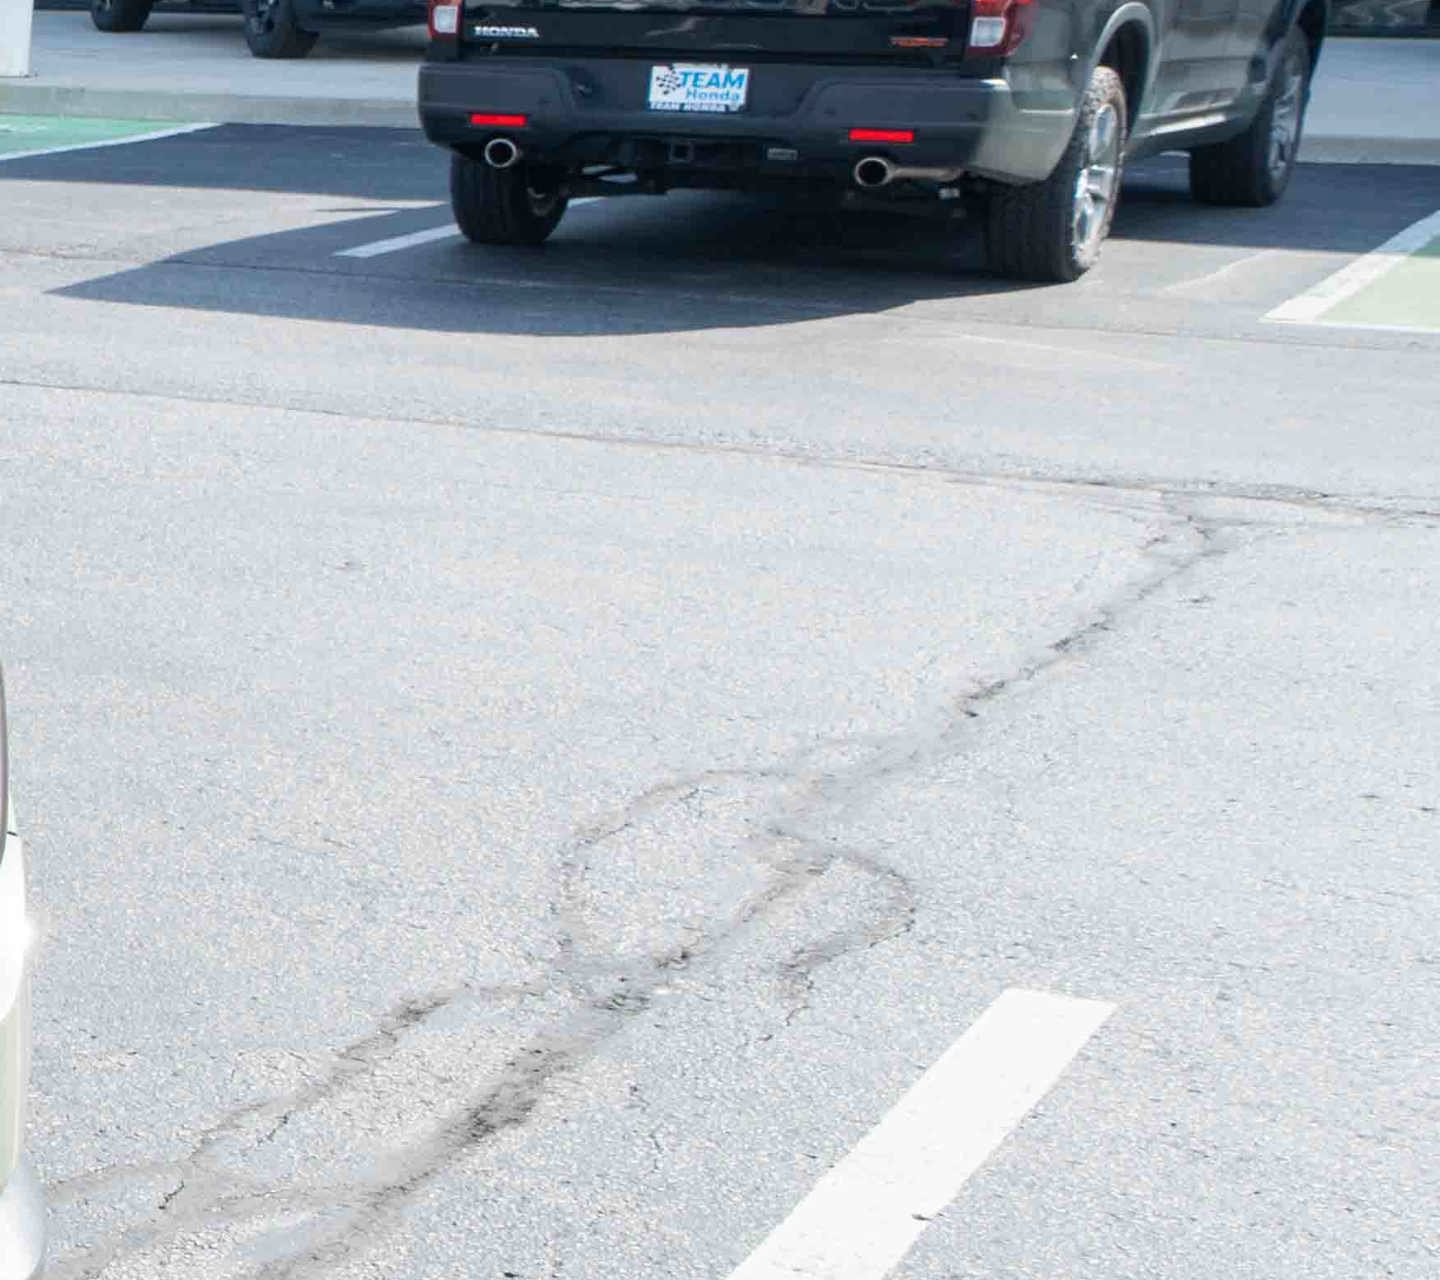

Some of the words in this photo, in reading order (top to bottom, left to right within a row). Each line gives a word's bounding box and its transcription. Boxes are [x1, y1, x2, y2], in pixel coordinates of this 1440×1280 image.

[474, 25, 540, 38] HONDA
[679, 71, 746, 89] TEAM
[685, 88, 741, 101] Honda
